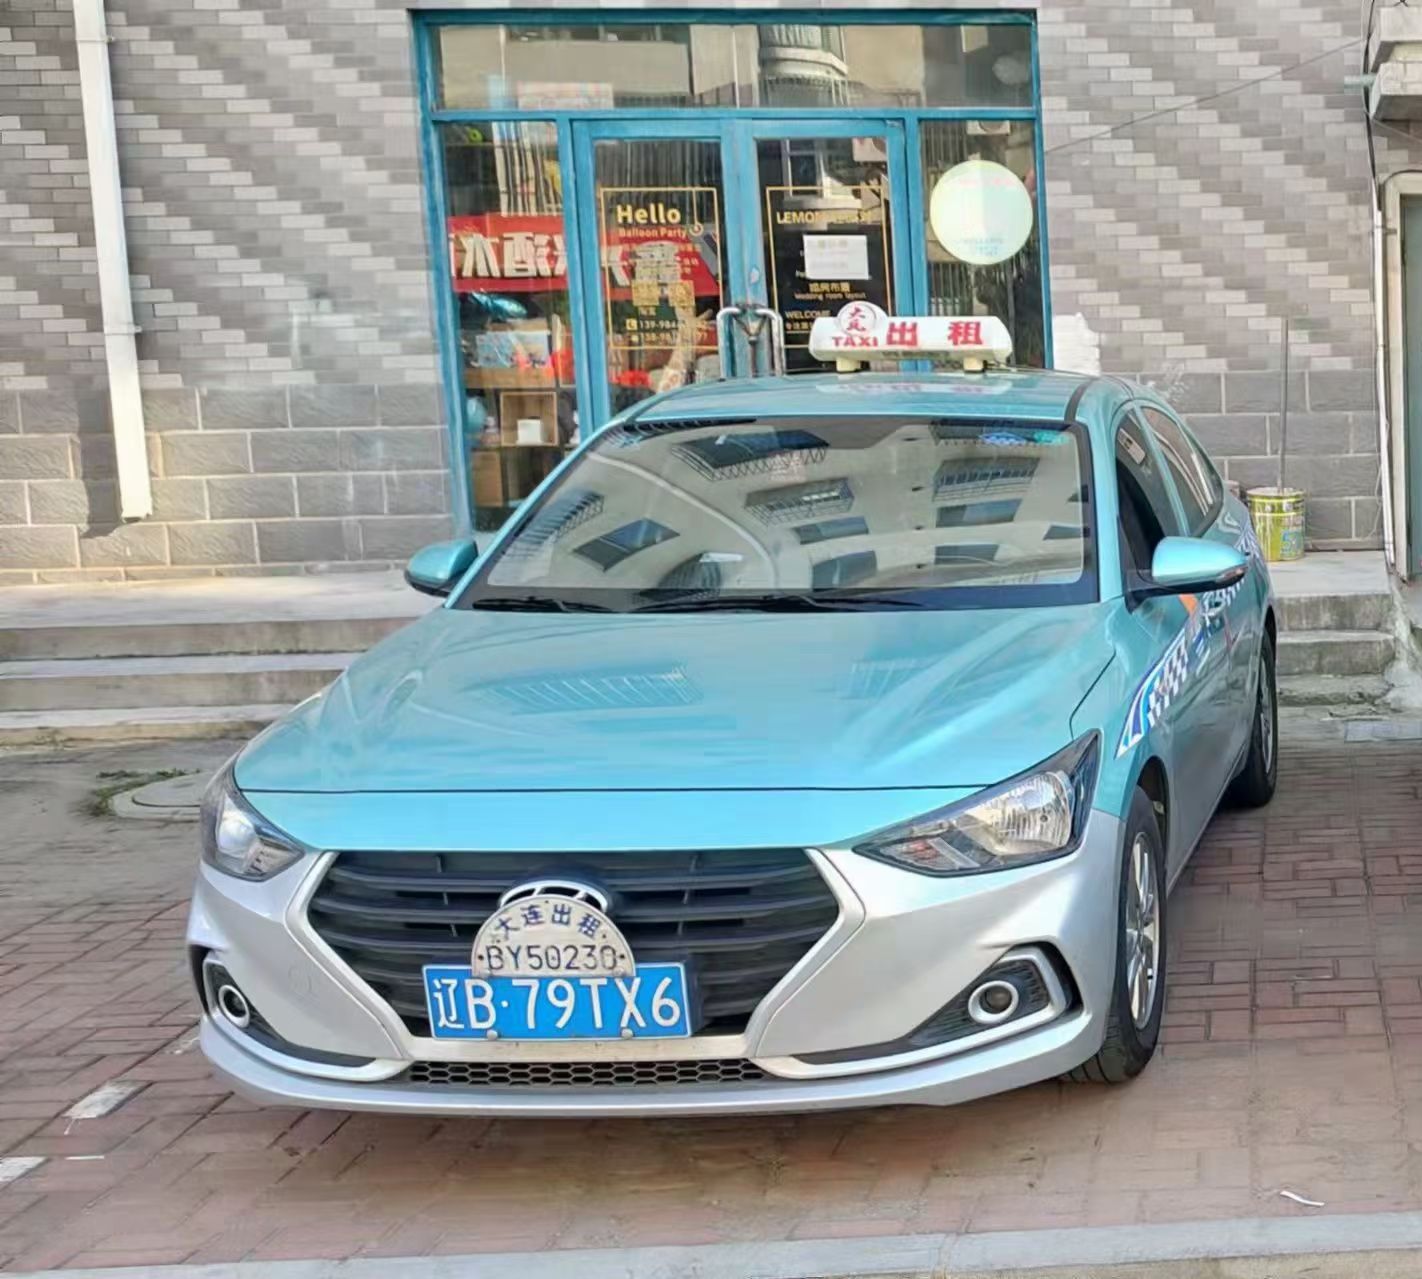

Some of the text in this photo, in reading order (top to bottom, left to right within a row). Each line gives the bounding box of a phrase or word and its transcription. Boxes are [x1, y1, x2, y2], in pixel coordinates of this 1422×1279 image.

[616, 203, 682, 224] Hello
[618, 226, 689, 240] Balloon Party
[784, 309, 832, 320] WELCOME
[831, 335, 879, 348] TAXI
[886, 321, 983, 347] 出租
[496, 902, 603, 940] 大连出租
[485, 944, 618, 972] BY50230
